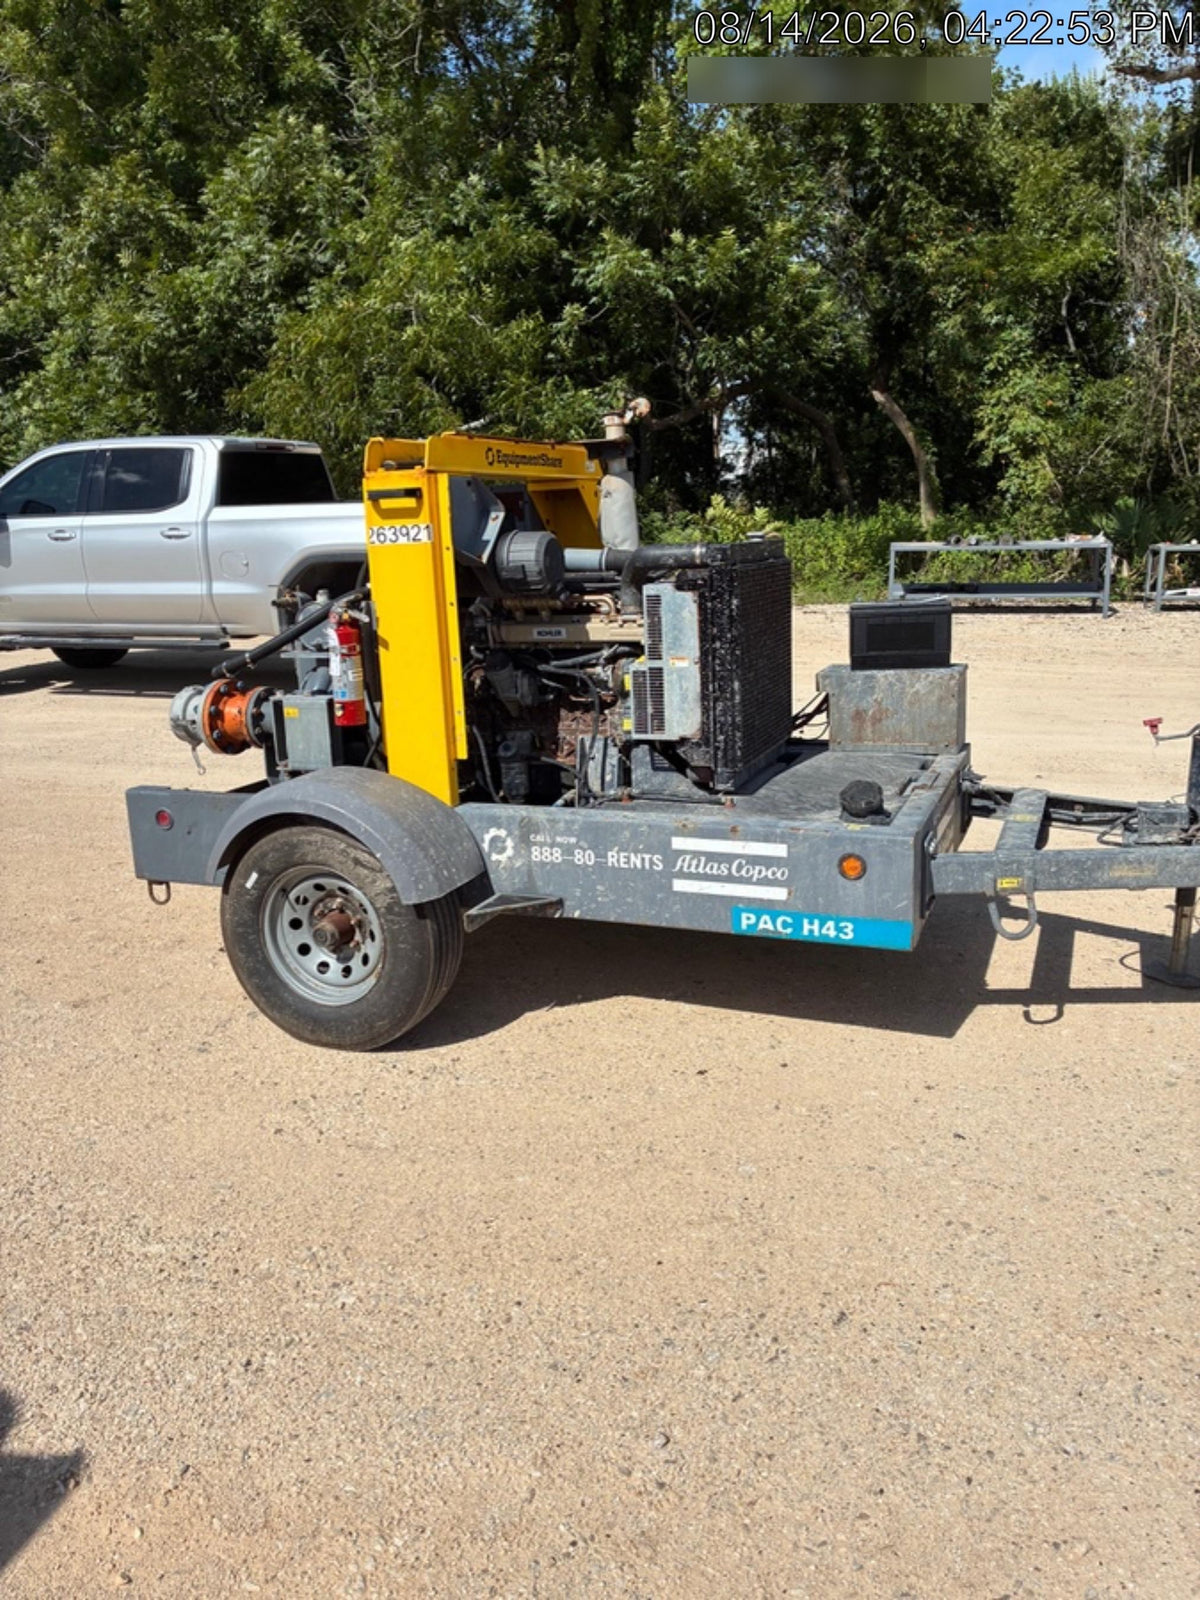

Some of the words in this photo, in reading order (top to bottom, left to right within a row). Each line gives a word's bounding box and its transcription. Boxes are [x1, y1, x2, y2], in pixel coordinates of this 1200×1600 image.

[496, 449, 562, 469] EquipmentShare
[368, 524, 432, 544] 263921
[556, 836, 577, 845] NOW
[672, 854, 729, 876] Atlas
[731, 858, 789, 882] Copco
[740, 912, 793, 934] PAC
[802, 918, 854, 940] H43
